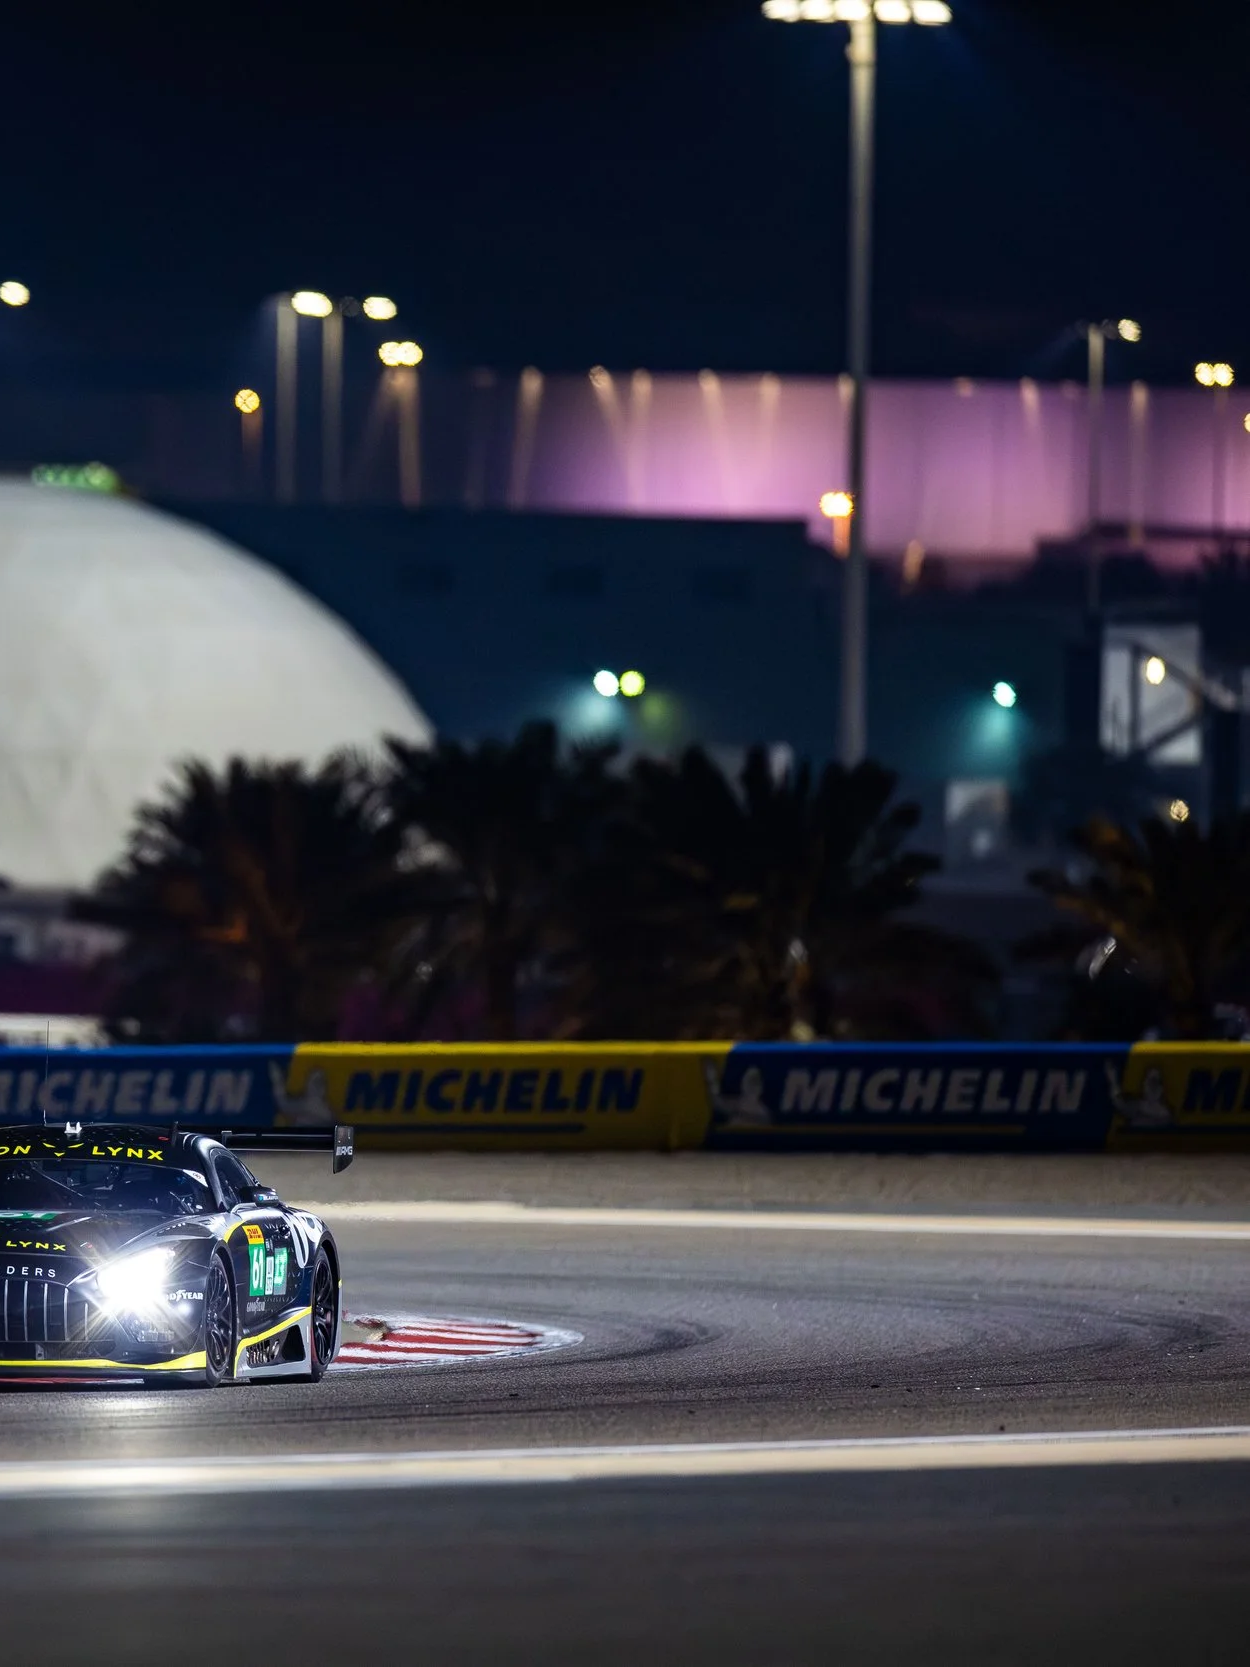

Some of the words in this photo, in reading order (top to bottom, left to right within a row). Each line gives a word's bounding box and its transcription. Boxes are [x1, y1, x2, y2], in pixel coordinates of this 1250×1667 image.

[344, 1068, 644, 1112] MICHELIN
[780, 1067, 1088, 1114] MICHELIN
[92, 1145, 164, 1161] LYNX
[6, 1240, 66, 1252] LYNX
[252, 1247, 264, 1290] 61
